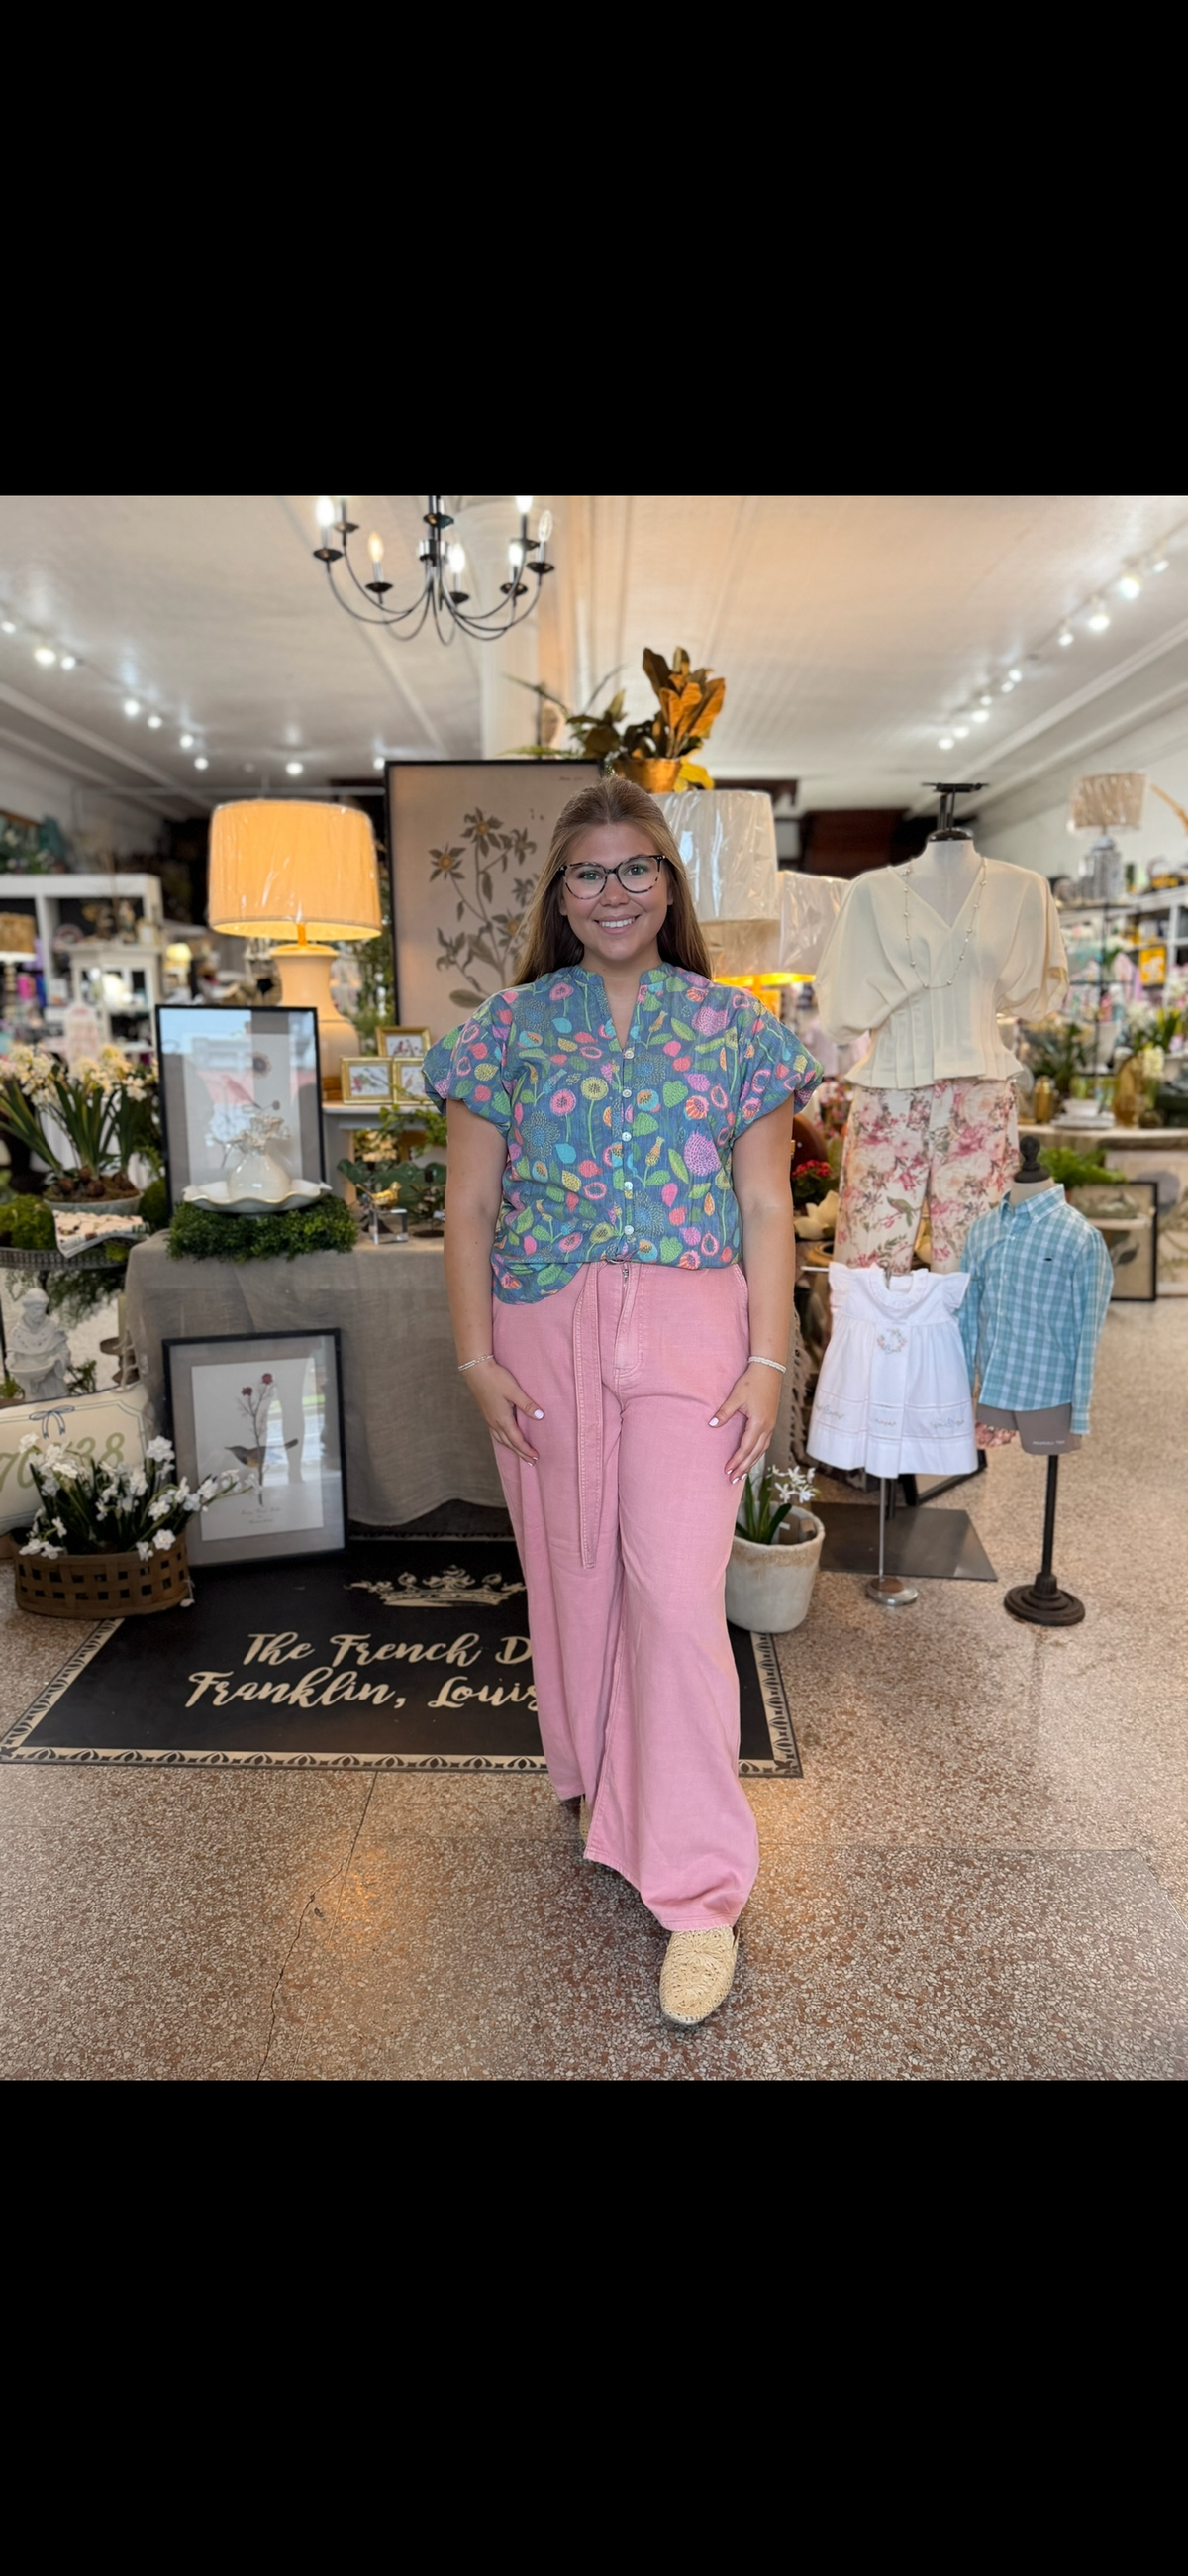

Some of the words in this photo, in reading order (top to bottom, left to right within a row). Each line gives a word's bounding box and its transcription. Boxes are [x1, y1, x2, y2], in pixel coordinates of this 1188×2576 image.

[0, 1432, 126, 1493] 7038
[243, 1631, 316, 1666] The
[329, 1632, 483, 1668] French
[185, 1666, 407, 1708] Franklin,
